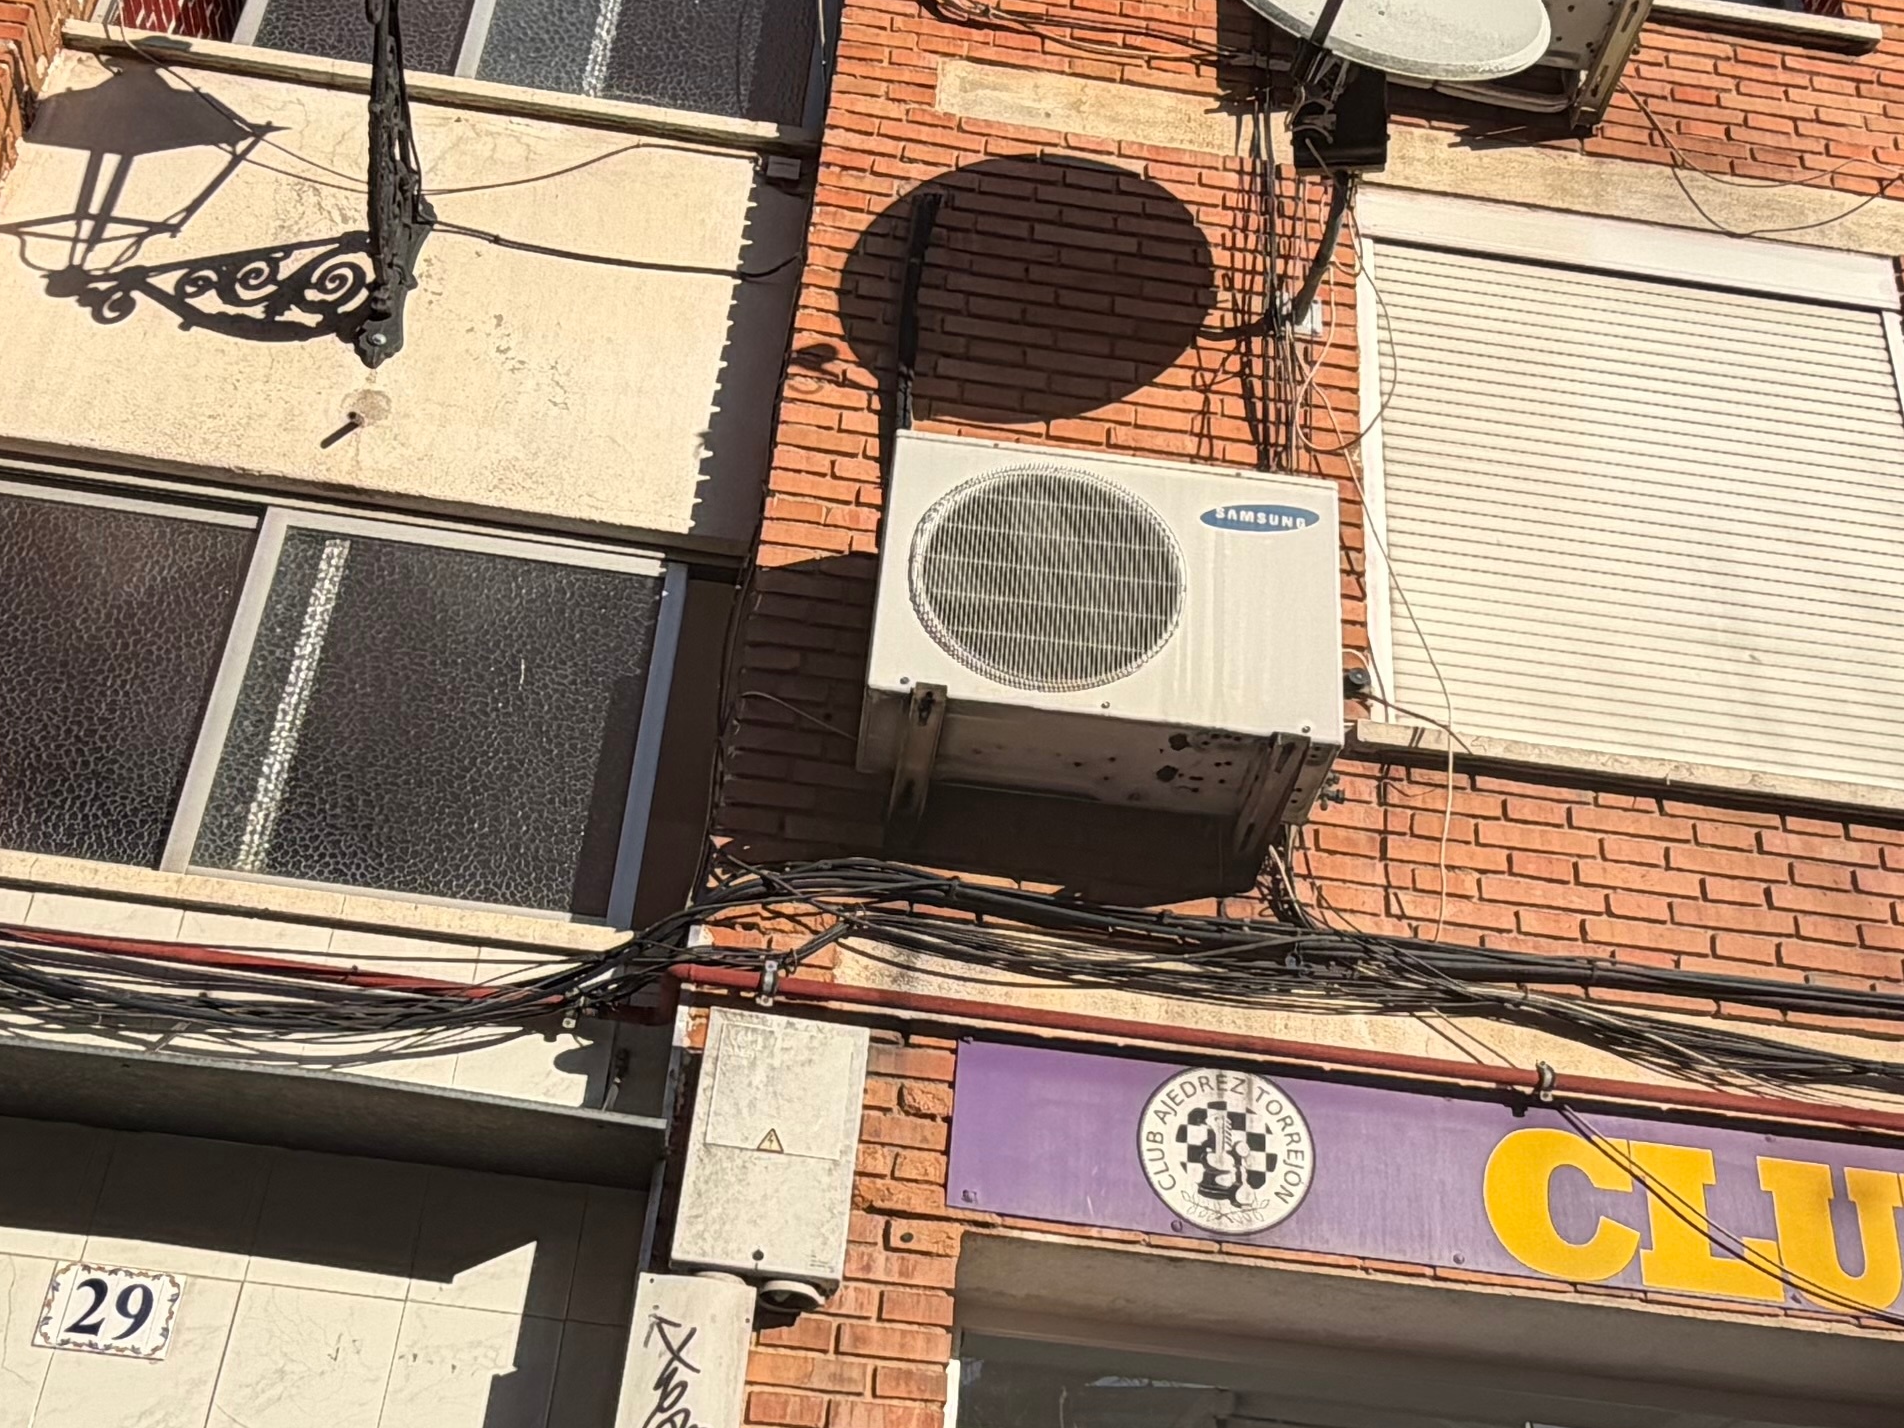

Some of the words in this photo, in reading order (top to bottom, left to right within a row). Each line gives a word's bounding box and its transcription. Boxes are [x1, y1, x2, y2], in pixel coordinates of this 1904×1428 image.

[1215, 507, 1307, 528] SAMSUNG
[1153, 1074, 1247, 1125] AJEDREZ
[1146, 1130, 1177, 1192] CLUB
[63, 1278, 154, 1341] 29
